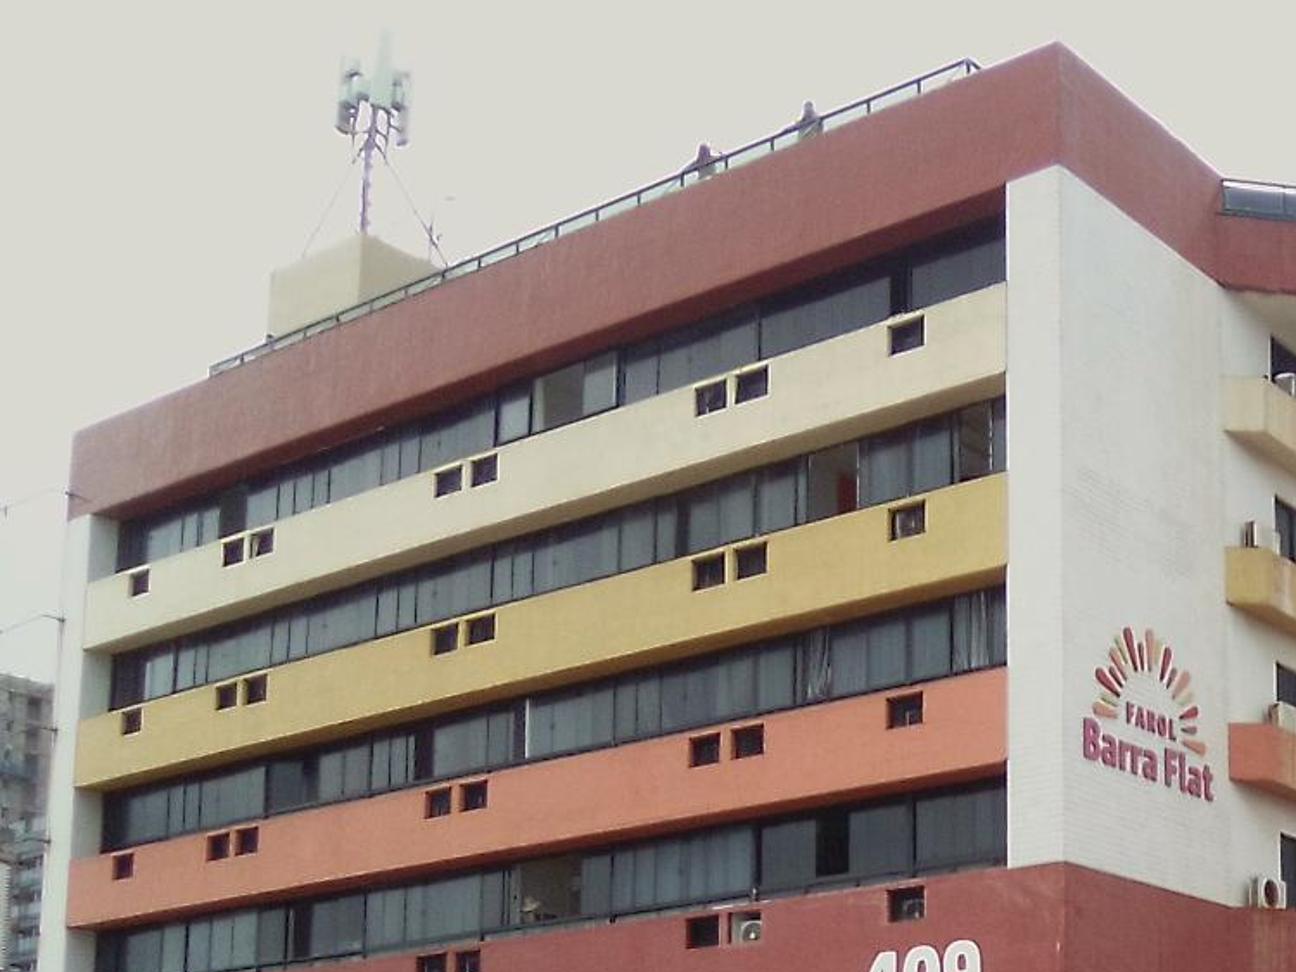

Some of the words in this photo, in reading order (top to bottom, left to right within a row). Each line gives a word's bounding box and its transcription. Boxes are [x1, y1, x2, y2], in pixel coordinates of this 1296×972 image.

[1126, 700, 1177, 742] FAROL
[1083, 716, 1158, 782] Barra
[1164, 747, 1214, 802] Flat
